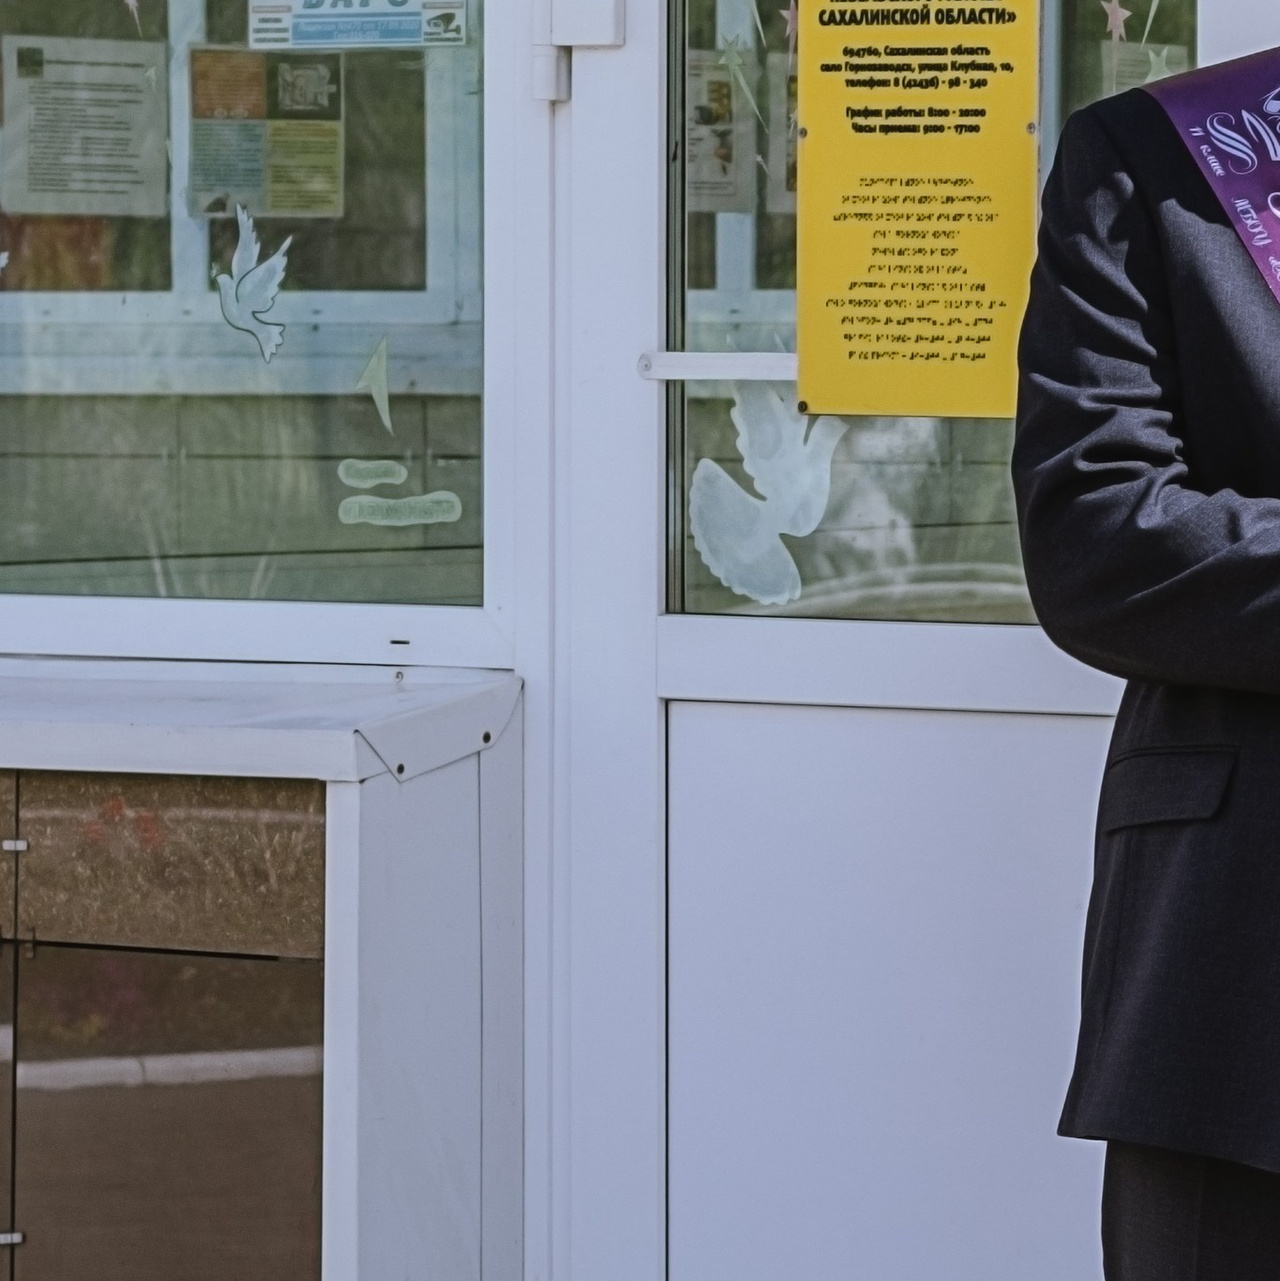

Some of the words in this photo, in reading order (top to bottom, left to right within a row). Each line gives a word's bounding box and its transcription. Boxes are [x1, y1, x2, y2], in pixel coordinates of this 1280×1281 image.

[818, 3, 931, 27] САХАЛИНСКОЙ
[934, 6, 1018, 26] ОБЛАСТИ»
[884, 44, 948, 58] Сахалинская
[950, 43, 991, 57] область
[917, 62, 948, 75] улица
[845, 106, 883, 120] График
[851, 122, 877, 133] Часы
[1231, 196, 1274, 248] МБОУ
